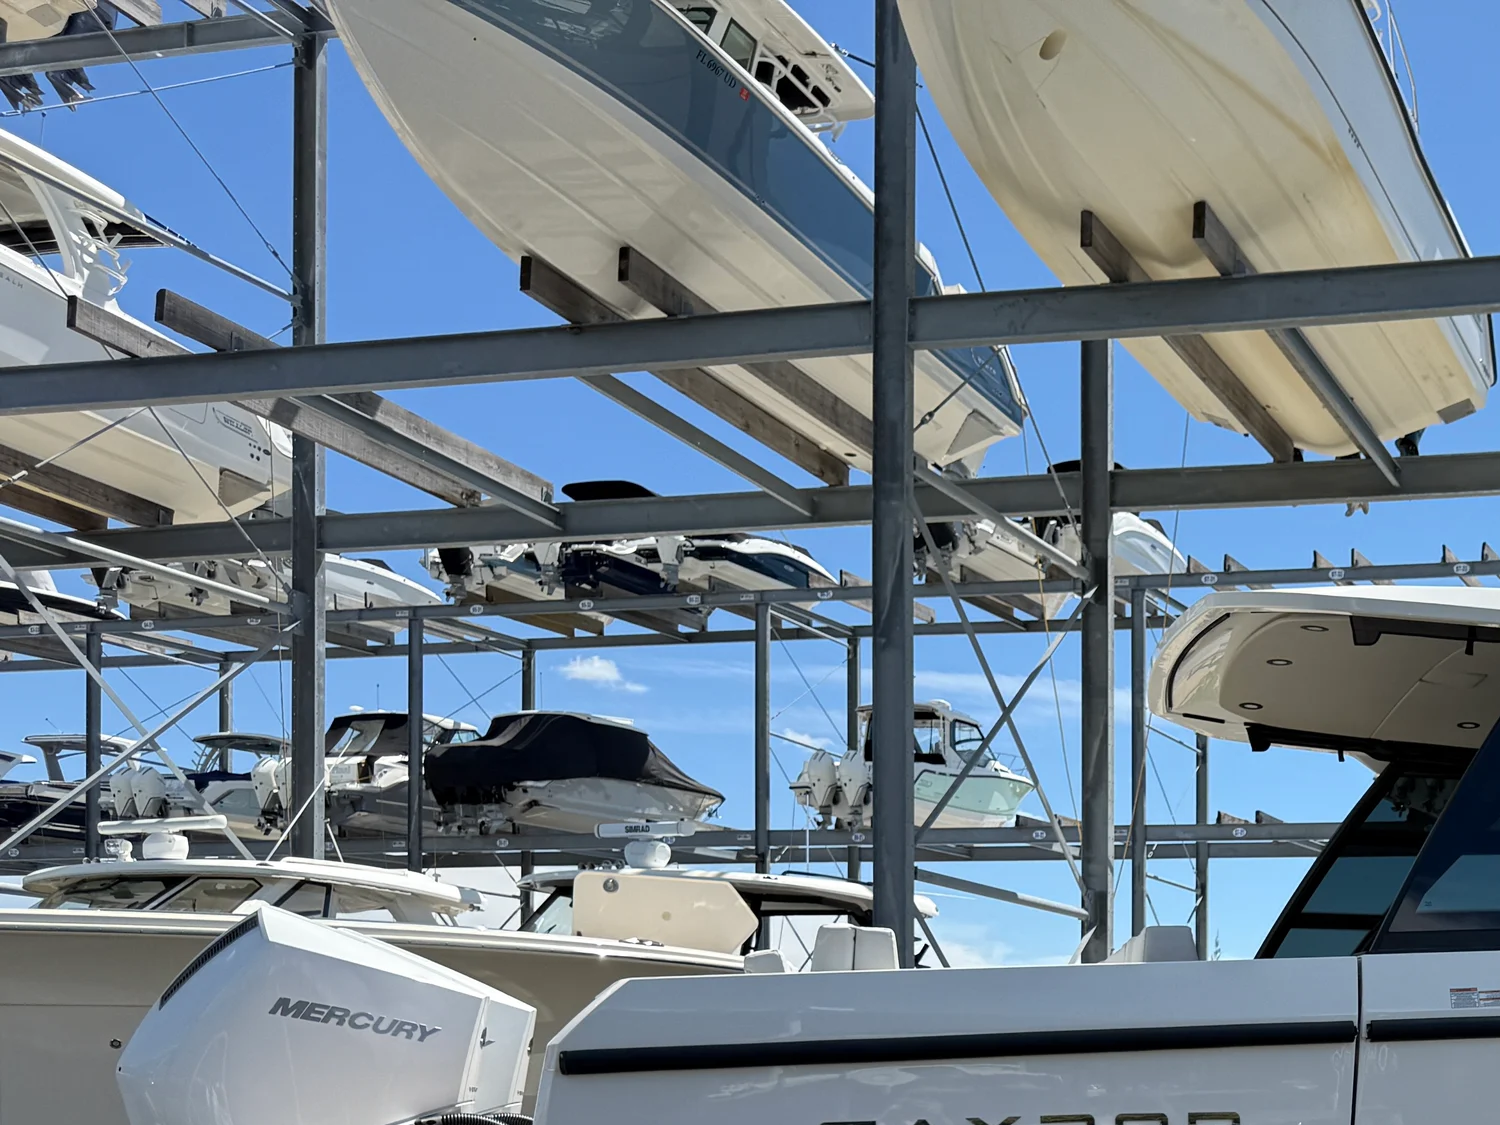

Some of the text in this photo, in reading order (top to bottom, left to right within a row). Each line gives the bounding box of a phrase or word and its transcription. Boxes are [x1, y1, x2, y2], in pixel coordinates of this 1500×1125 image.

[696, 50, 737, 88] FL 6967 UD
[624, 825, 650, 833] SIMRAD
[268, 997, 442, 1042] MERCURY
